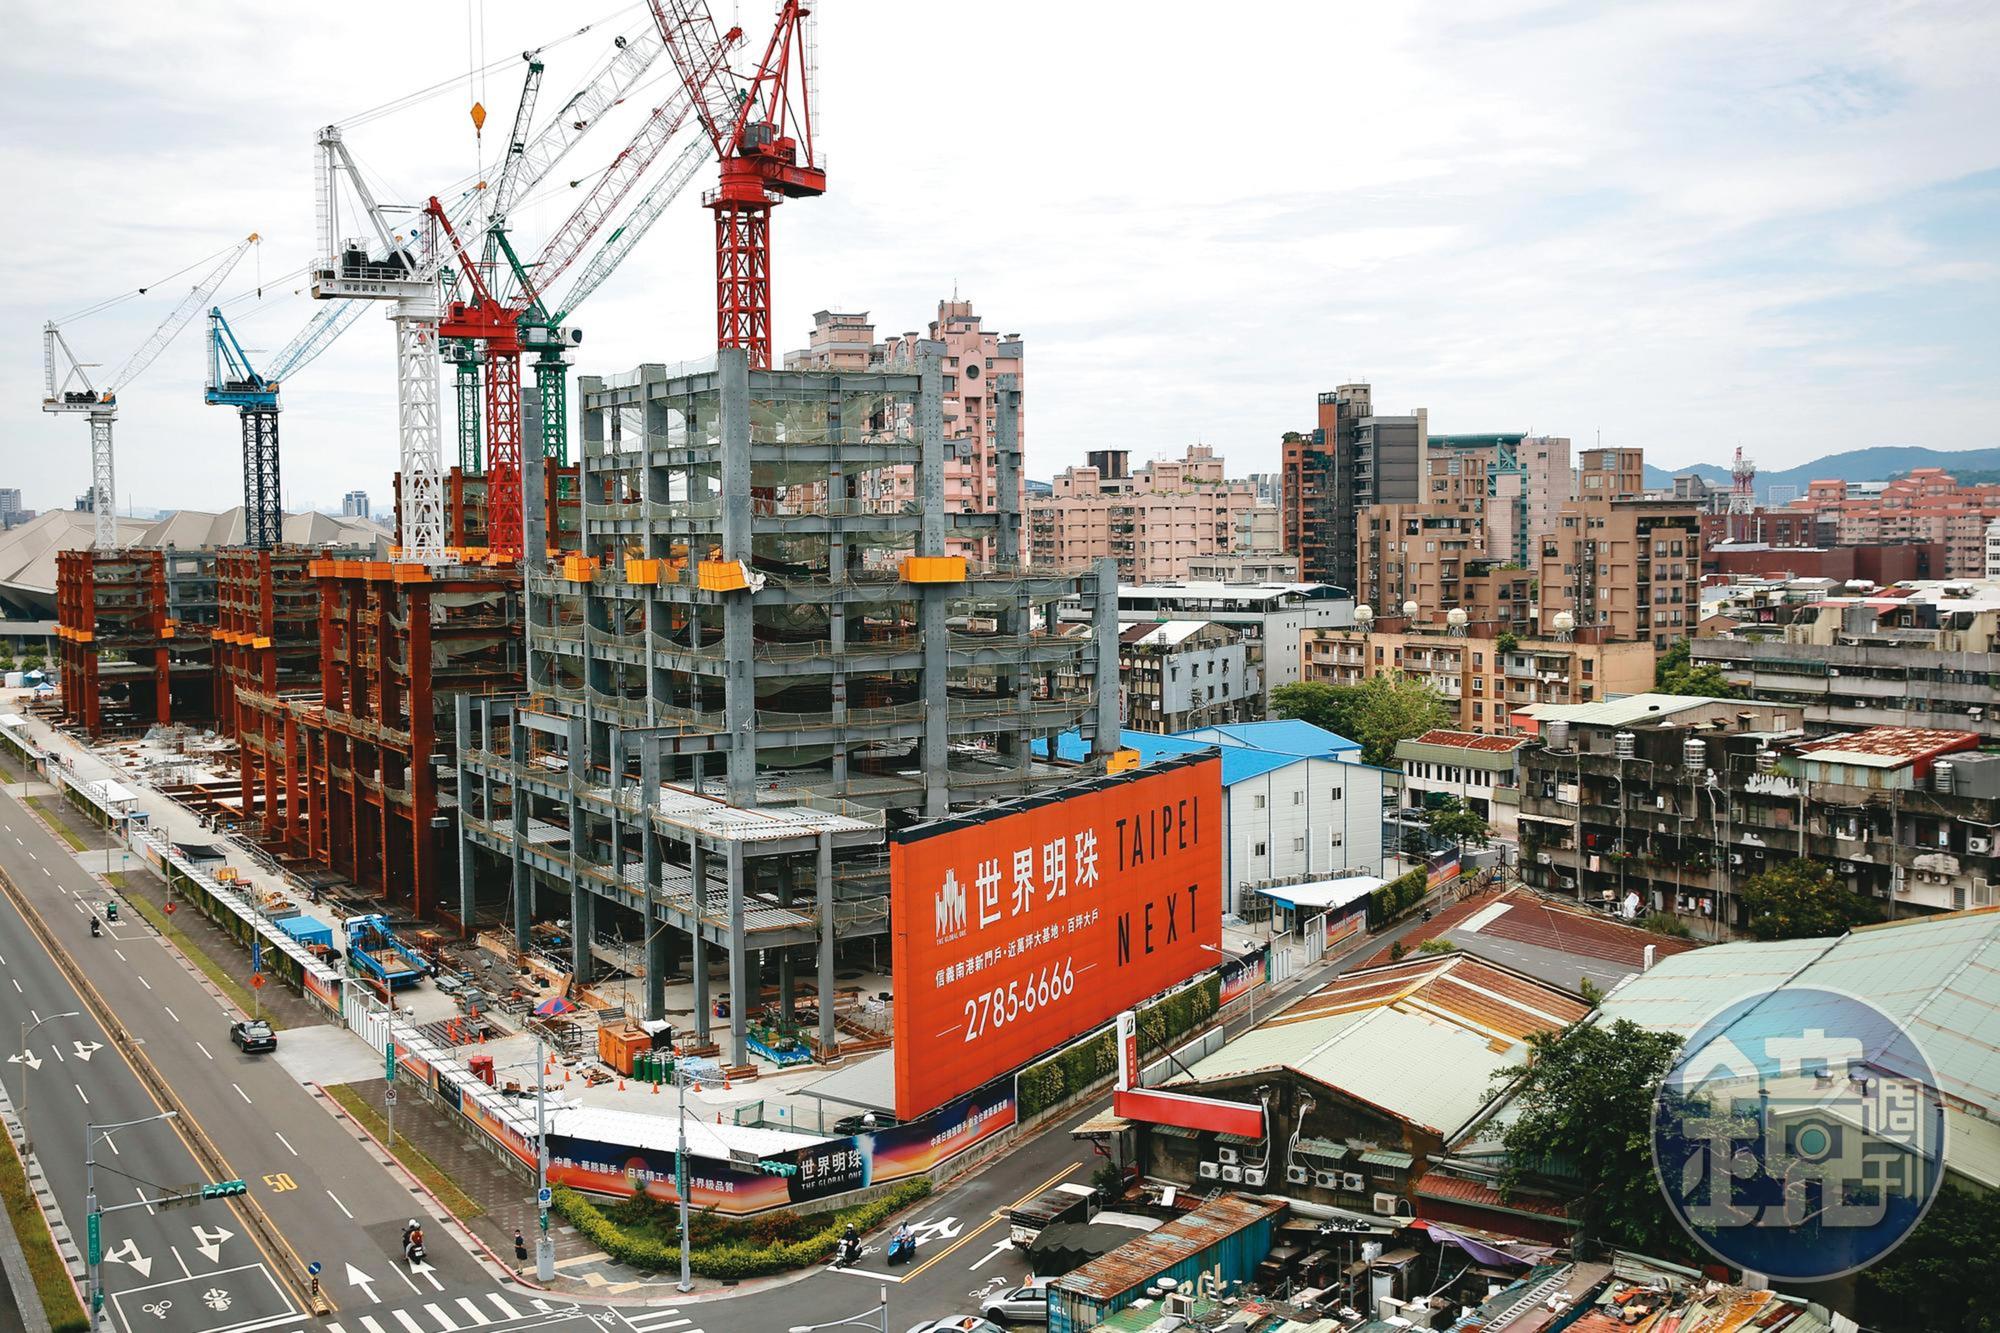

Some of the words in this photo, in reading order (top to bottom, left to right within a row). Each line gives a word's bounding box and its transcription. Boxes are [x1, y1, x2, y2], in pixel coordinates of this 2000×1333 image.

[1116, 796, 1198, 872] TAIPEI
[975, 828, 1099, 930] 世界明珠
[1118, 884, 1198, 967] NEXT
[964, 956, 1074, 1043] 2785-6666
[262, 1173, 298, 1192] 50
[667, 1173, 735, 1193] 營世界級品質
[800, 1148, 862, 1181] 世界明珠
[801, 1182, 815, 1190] THE
